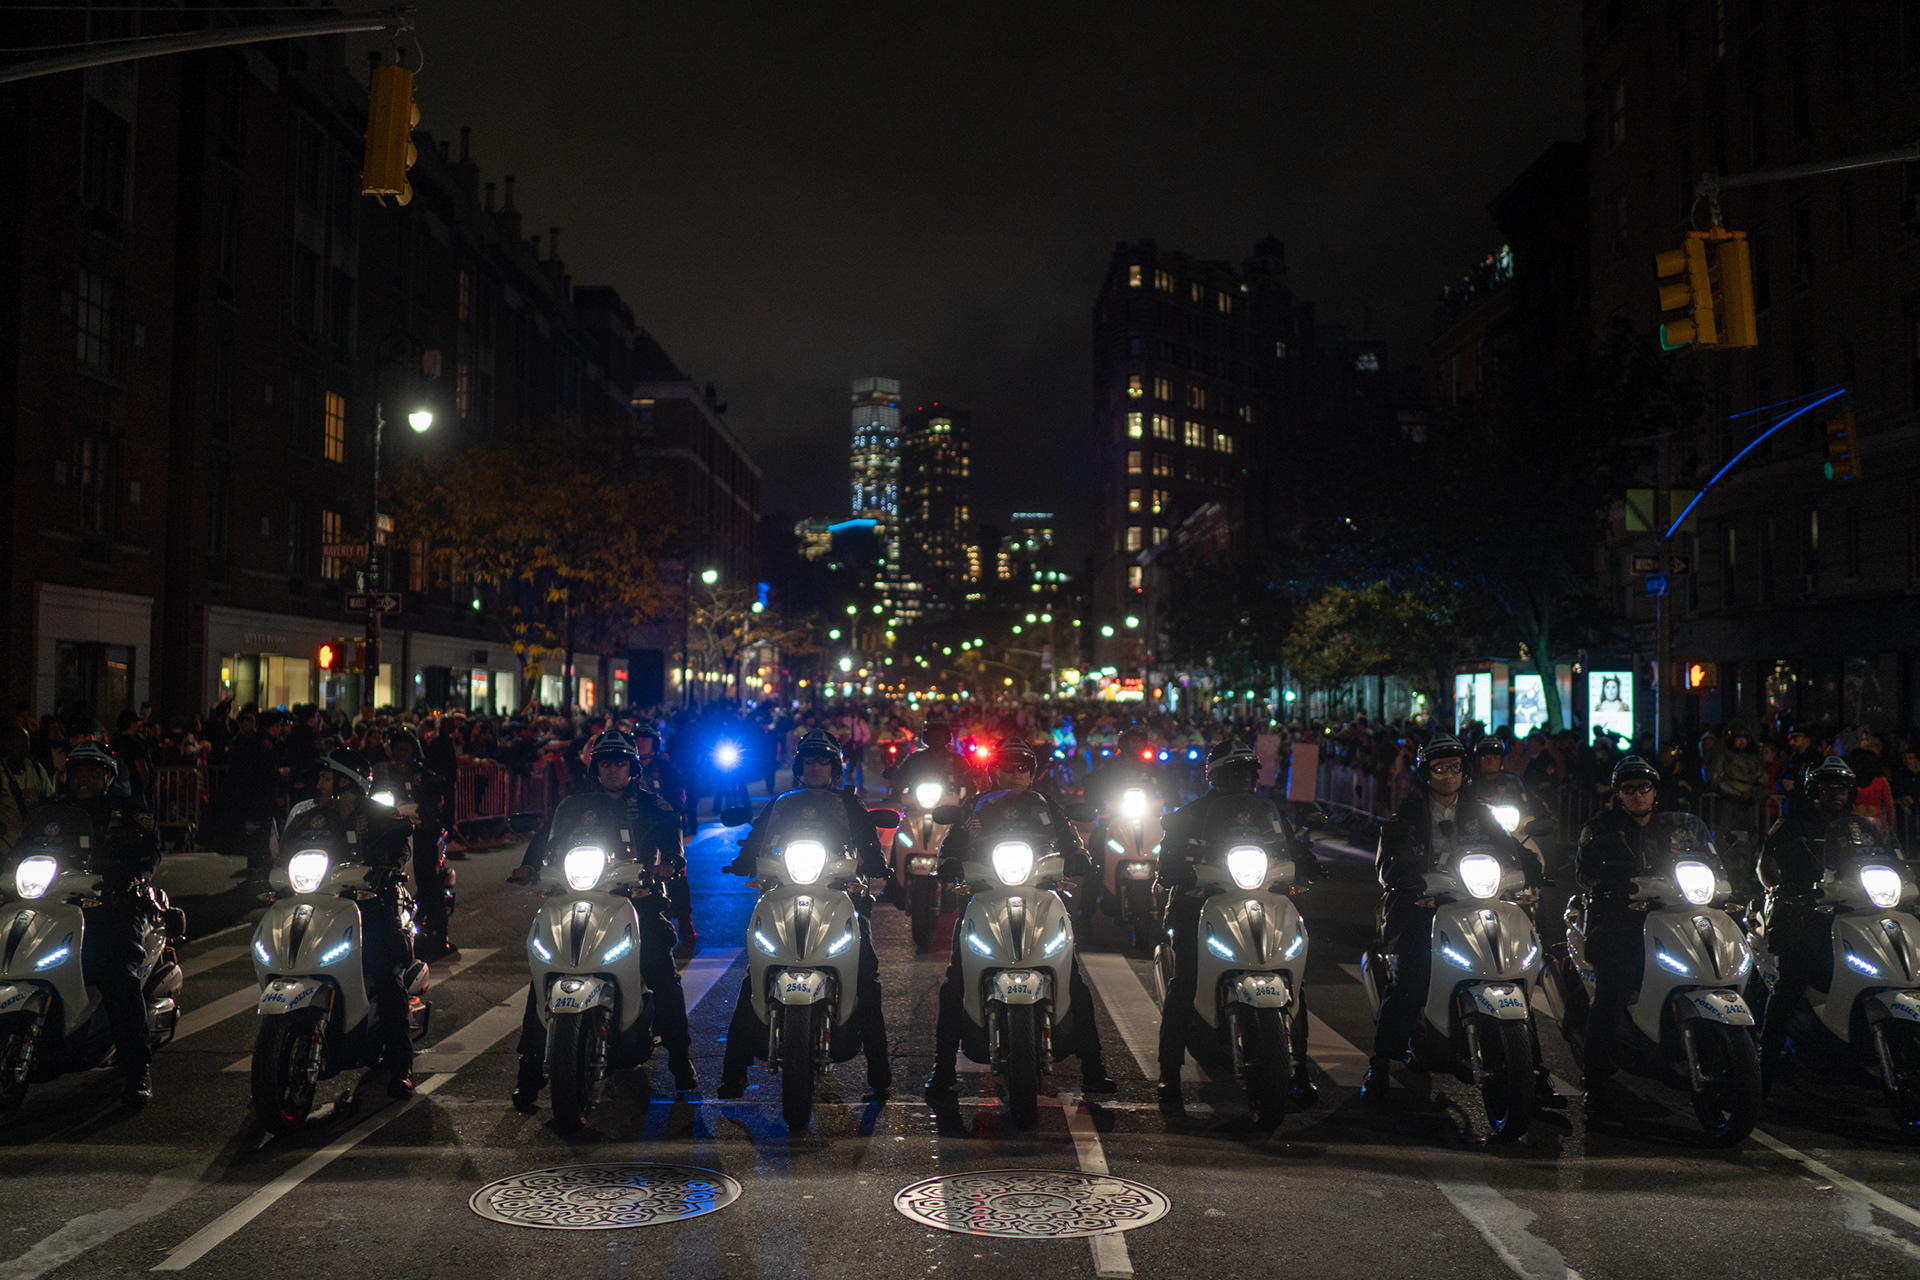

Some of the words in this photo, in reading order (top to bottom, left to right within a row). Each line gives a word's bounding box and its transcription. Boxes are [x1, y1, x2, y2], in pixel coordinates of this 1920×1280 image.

[323, 545, 354, 556] WAVERLY
[786, 983, 807, 992] 2545
[1007, 985, 1028, 994] 2457
[1256, 986, 1276, 996] 2462
[0, 991, 27, 1009] OLICE
[262, 993, 284, 1003] 2446
[289, 987, 314, 1009] POLICE
[585, 984, 601, 1007] POLICE
[555, 997, 576, 1007] 2471
[1499, 998, 1520, 1008] 2546
[1695, 997, 1722, 1019] POLICE
[1890, 1003, 1918, 1020] POLICE
